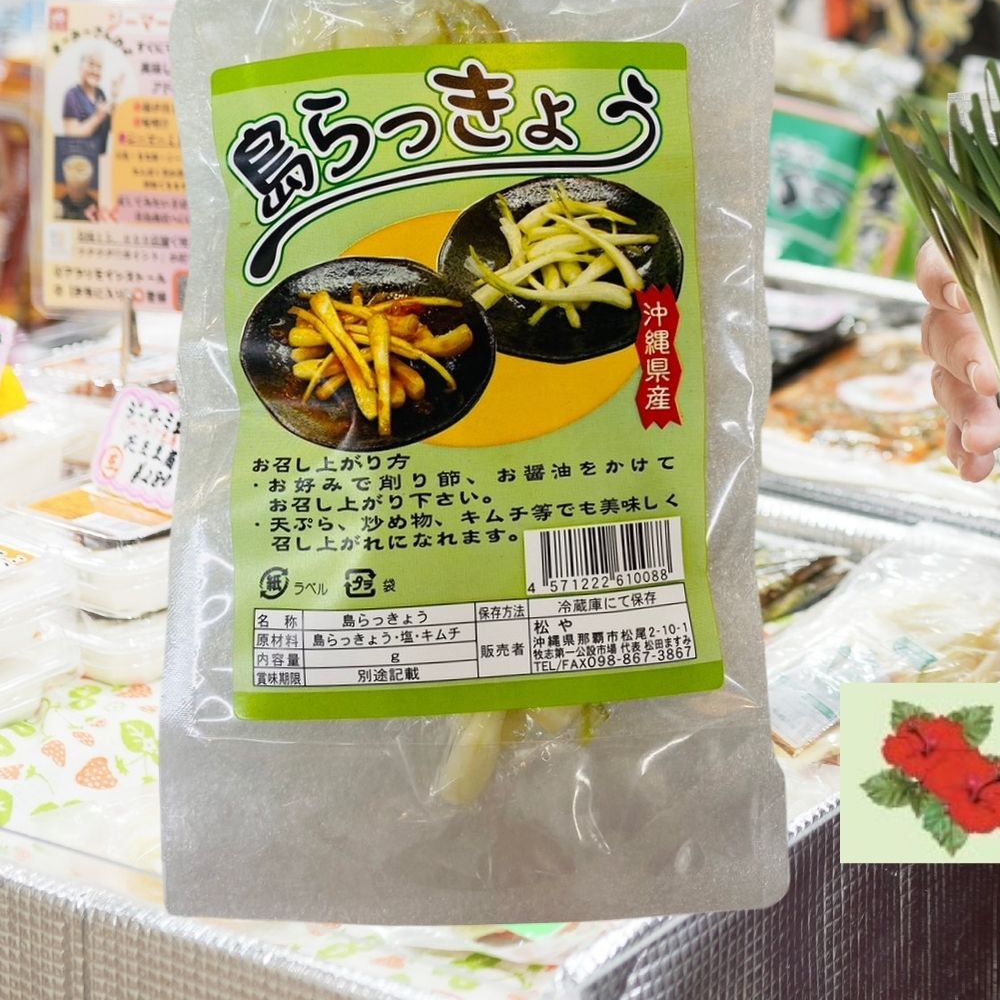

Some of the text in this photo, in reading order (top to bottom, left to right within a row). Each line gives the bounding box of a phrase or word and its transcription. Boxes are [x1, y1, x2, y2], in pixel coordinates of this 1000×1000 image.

[227, 57, 663, 230] 島らっきょう
[643, 301, 671, 411] 沖縄県産
[252, 453, 410, 473] お召し上がり方
[269, 491, 492, 513] お召し上がり下さい。
[294, 581, 328, 596] ラベル
[383, 578, 396, 593] 袋
[478, 591, 657, 619] 保存方法 冷蔵庫にて保存
[342, 610, 428, 627] 島らっきょう
[533, 618, 573, 634] 松や
[256, 633, 299, 648] 原材料
[480, 636, 691, 660] 販売者 牧志第一公設市場 代表 松田ますみ
[256, 652, 400, 667] 内容量 g
[256, 667, 420, 685] 賞味期限 別途記載
